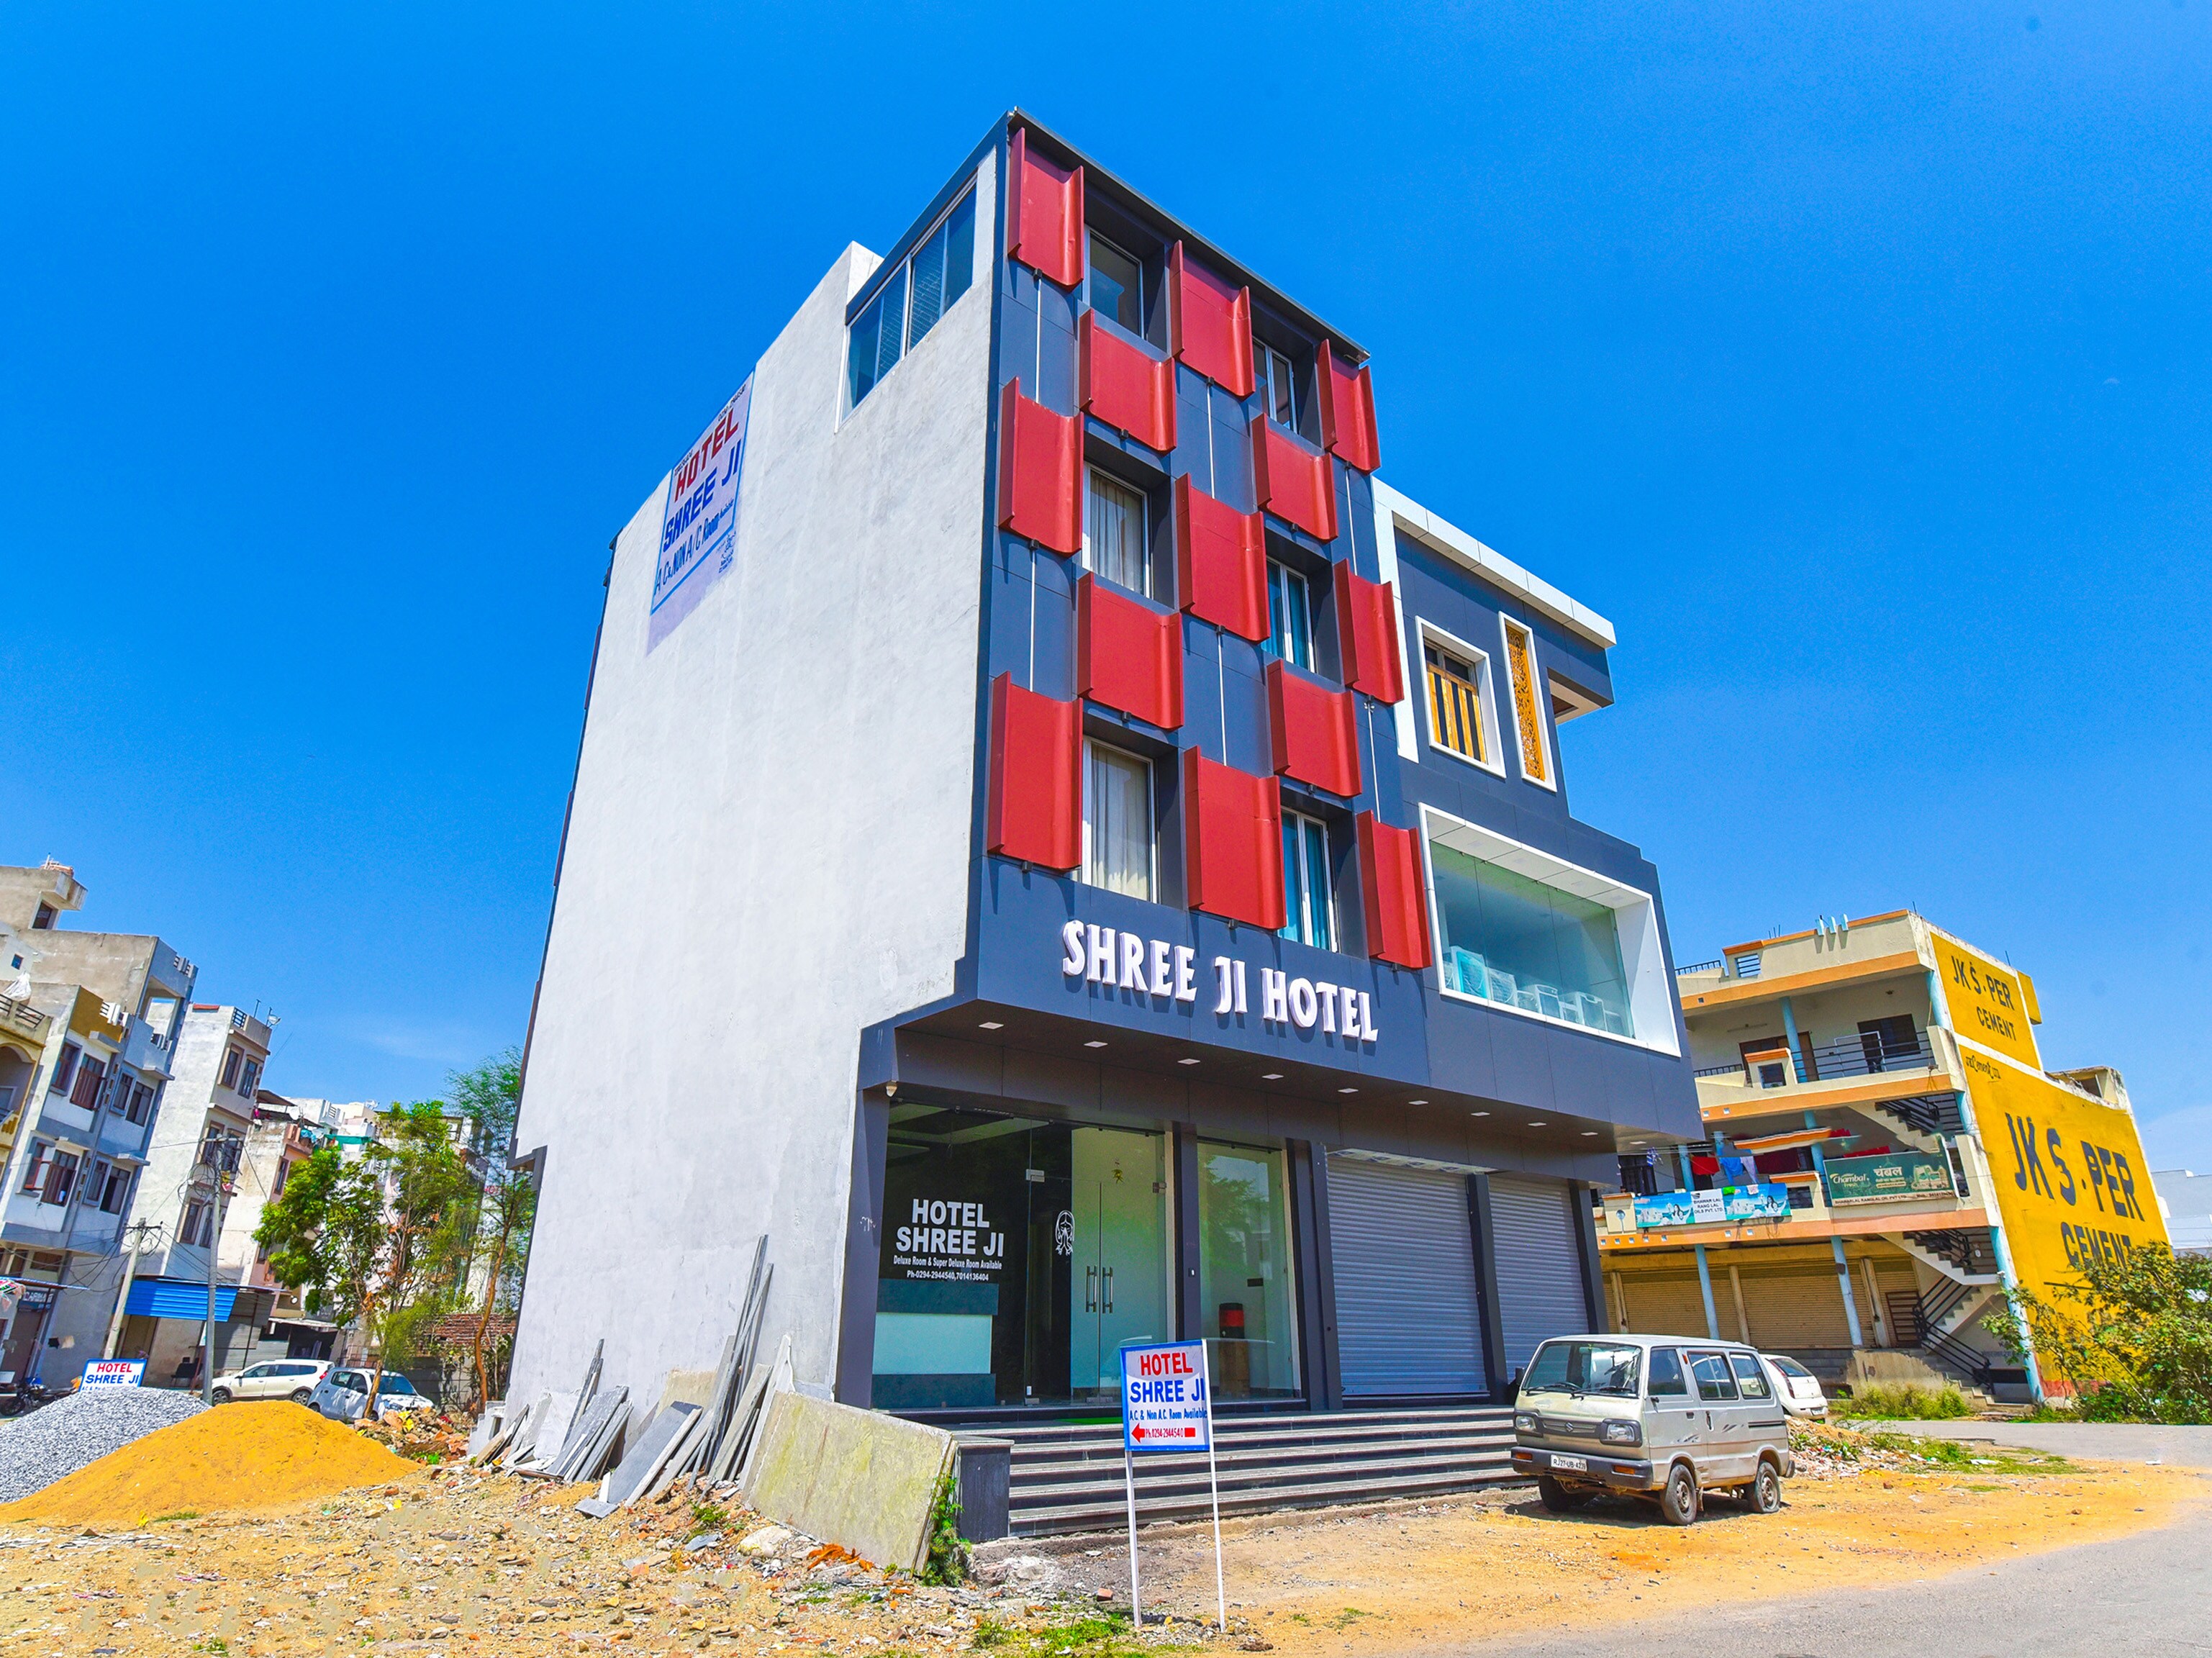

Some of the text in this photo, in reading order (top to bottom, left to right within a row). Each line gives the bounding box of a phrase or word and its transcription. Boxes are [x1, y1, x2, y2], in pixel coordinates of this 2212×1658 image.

[675, 407, 739, 503] HOTEL
[663, 466, 717, 553] SHREE
[721, 438, 741, 486] JI
[1062, 920, 1379, 1042] SHREE JI HOTEL
[1976, 1006, 2016, 1041] CEMENT
[1833, 1174, 1866, 1184] Chambal
[1873, 1166, 1903, 1177] चंबल
[912, 1198, 989, 1228] HOTEL
[896, 1226, 1004, 1257] SHREE JI
[893, 1255, 1002, 1269] Deluxe Room & Super Deluxe Room Available
[96, 1363, 132, 1372] HOTEL
[1141, 1352, 1193, 1376] HOTEL
[85, 1374, 140, 1384] SHREE JI
[1130, 1378, 1205, 1403] SHREE JI
[1140, 1410, 1144, 1420] &
[1147, 1409, 1157, 1420] Non
[1169, 1408, 1182, 1420] Room
[1184, 1407, 1207, 1419] Available
